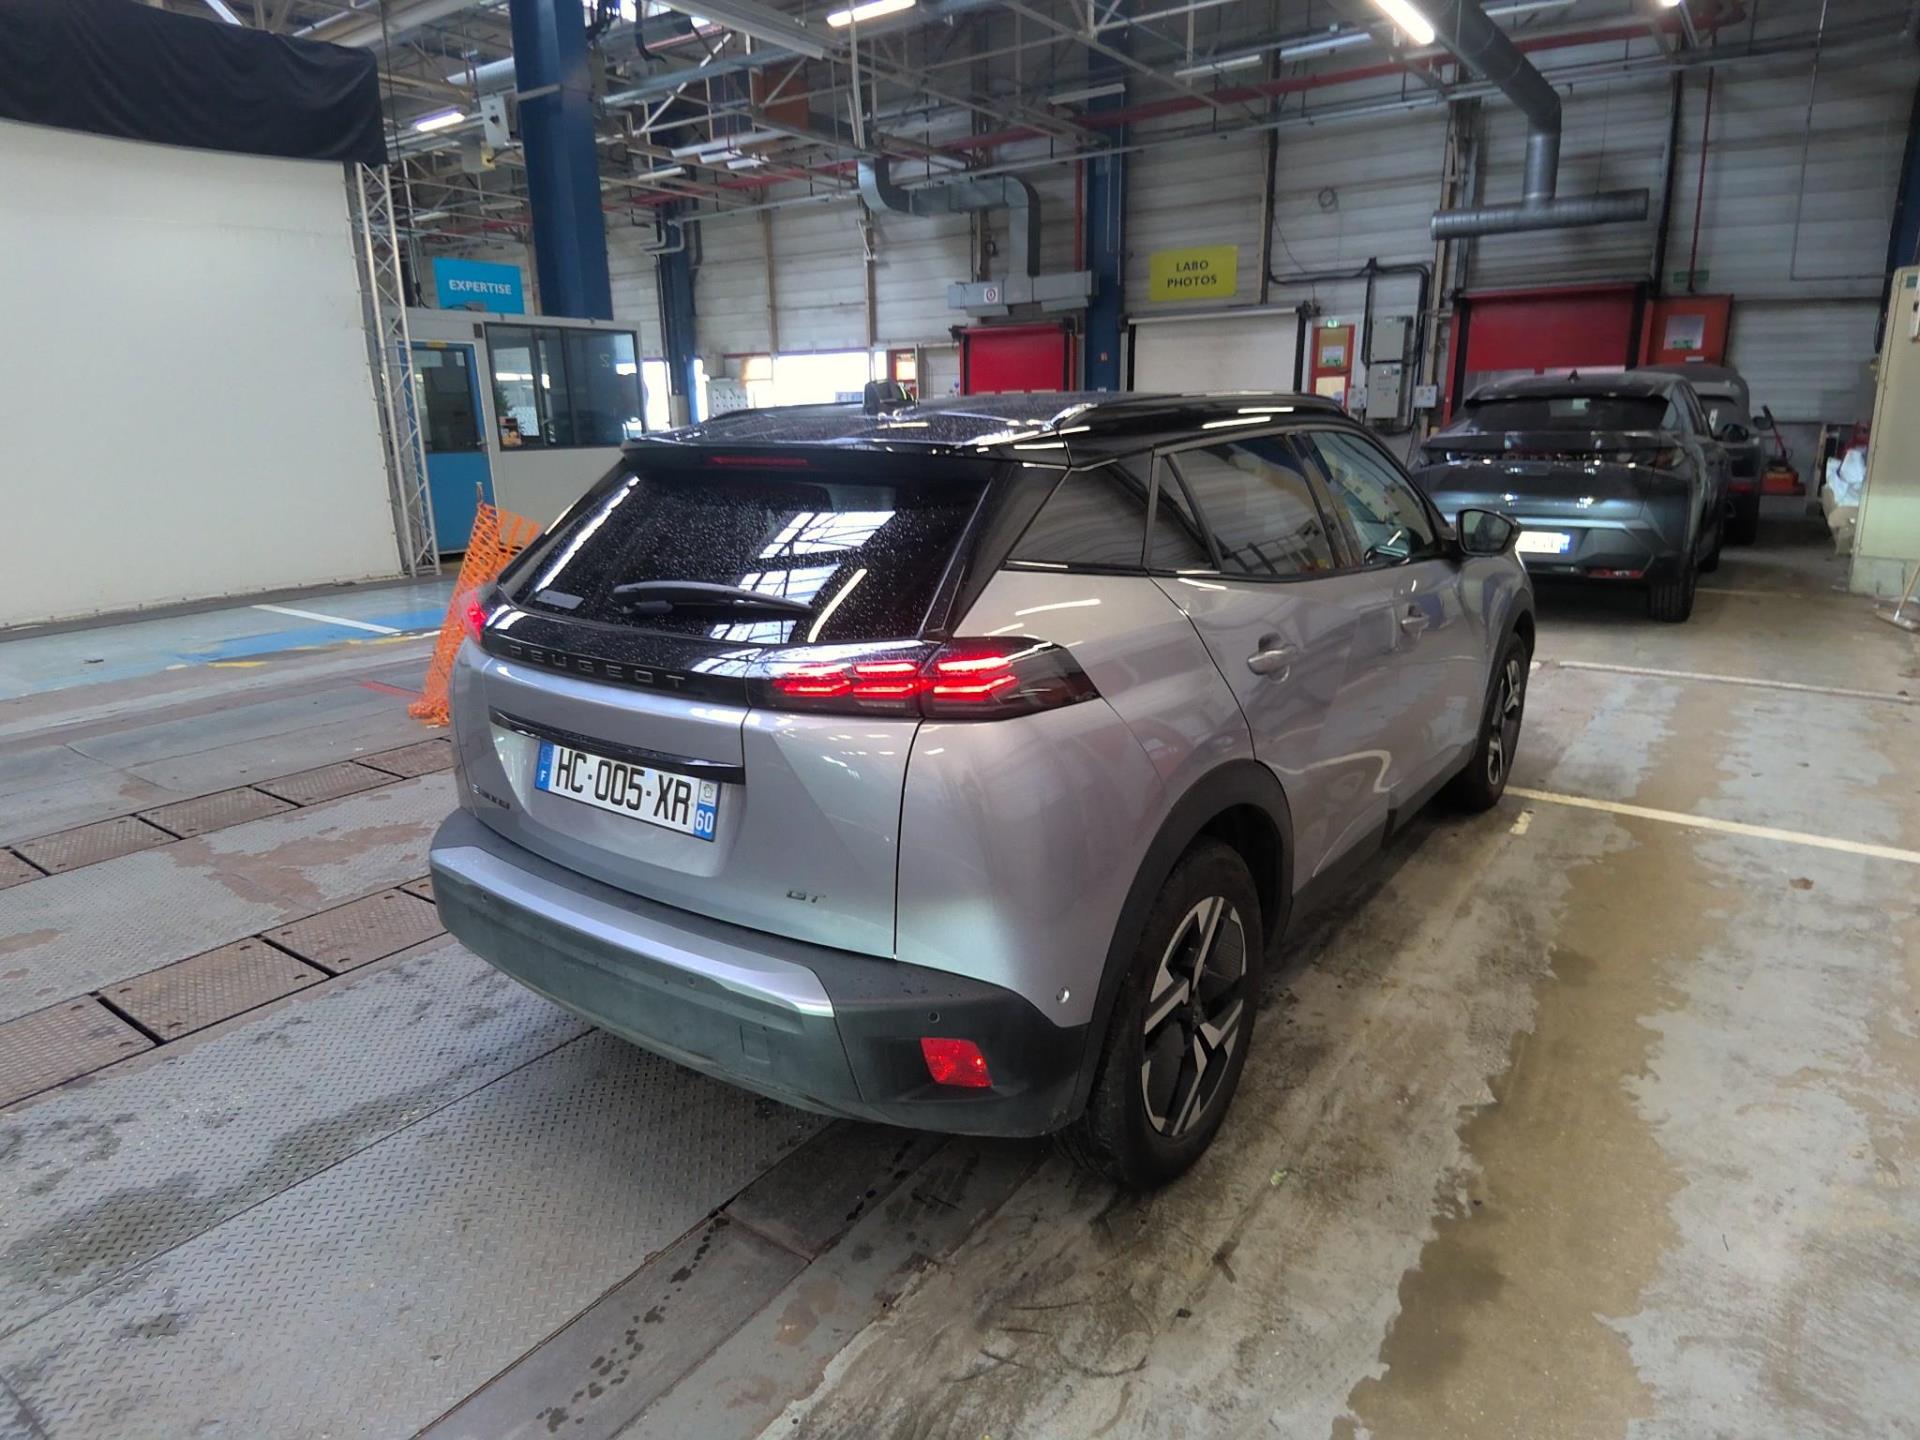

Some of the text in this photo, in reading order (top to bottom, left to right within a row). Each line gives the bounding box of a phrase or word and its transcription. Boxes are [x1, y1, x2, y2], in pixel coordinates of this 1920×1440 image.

[1176, 260, 1209, 272] LABO
[449, 279, 512, 295] EXPERTISE
[1167, 274, 1217, 288] PHOTOS
[509, 644, 685, 688] PEUGEOT
[540, 769, 547, 782] F
[695, 809, 714, 833] 60
